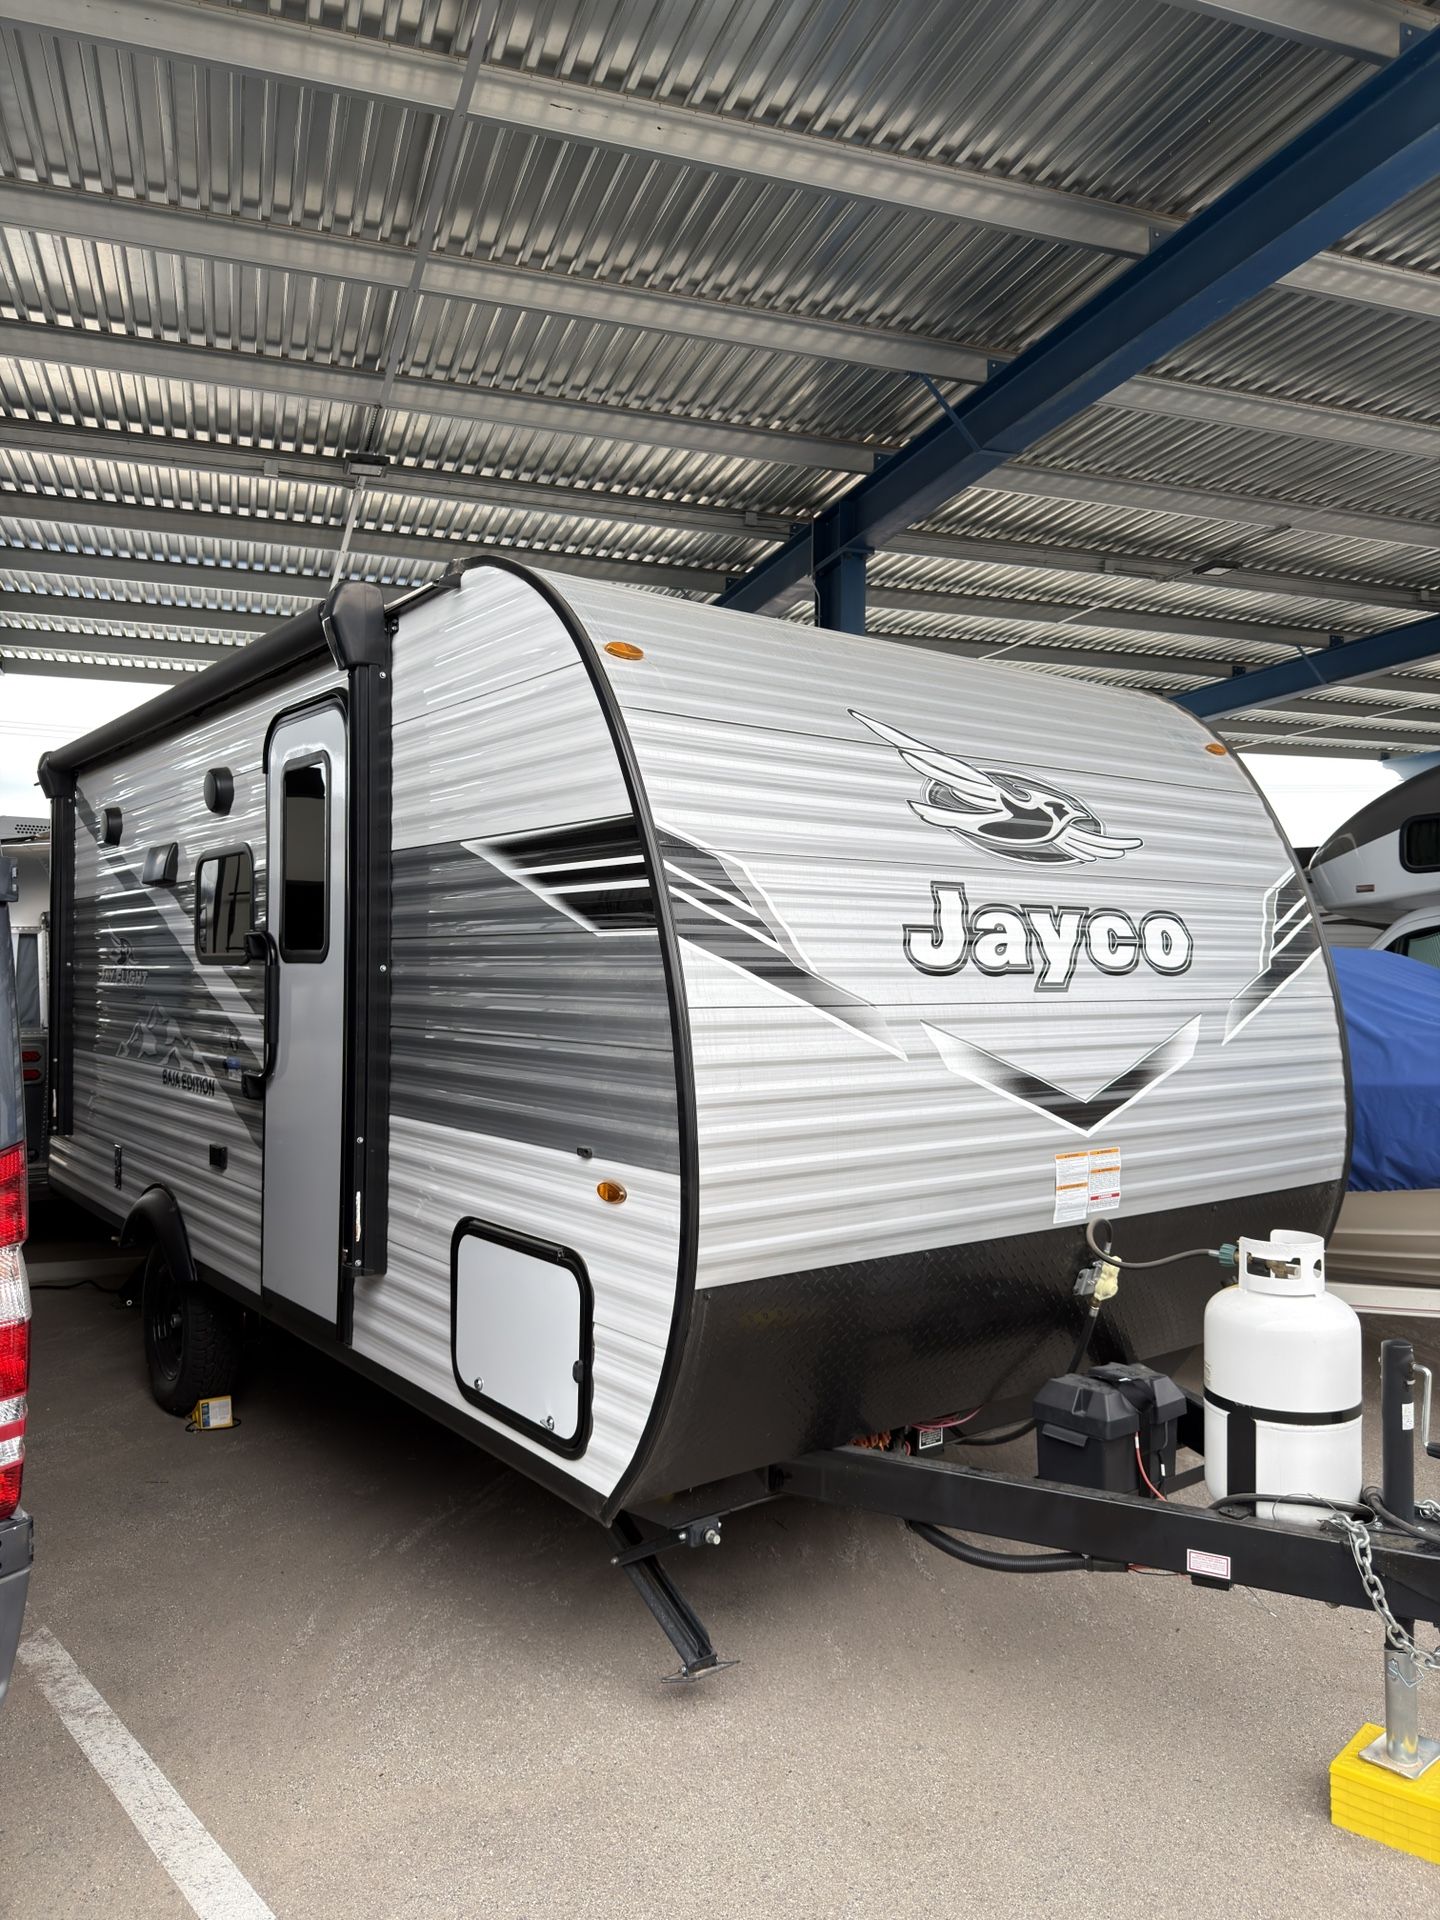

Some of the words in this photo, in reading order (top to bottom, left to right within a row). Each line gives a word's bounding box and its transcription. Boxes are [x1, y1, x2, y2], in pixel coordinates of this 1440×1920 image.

[902, 880, 1194, 993] Jayco
[115, 968, 149, 987] FLIGHT
[162, 1069, 181, 1088] BAJA
[181, 1073, 215, 1097] EDITION
